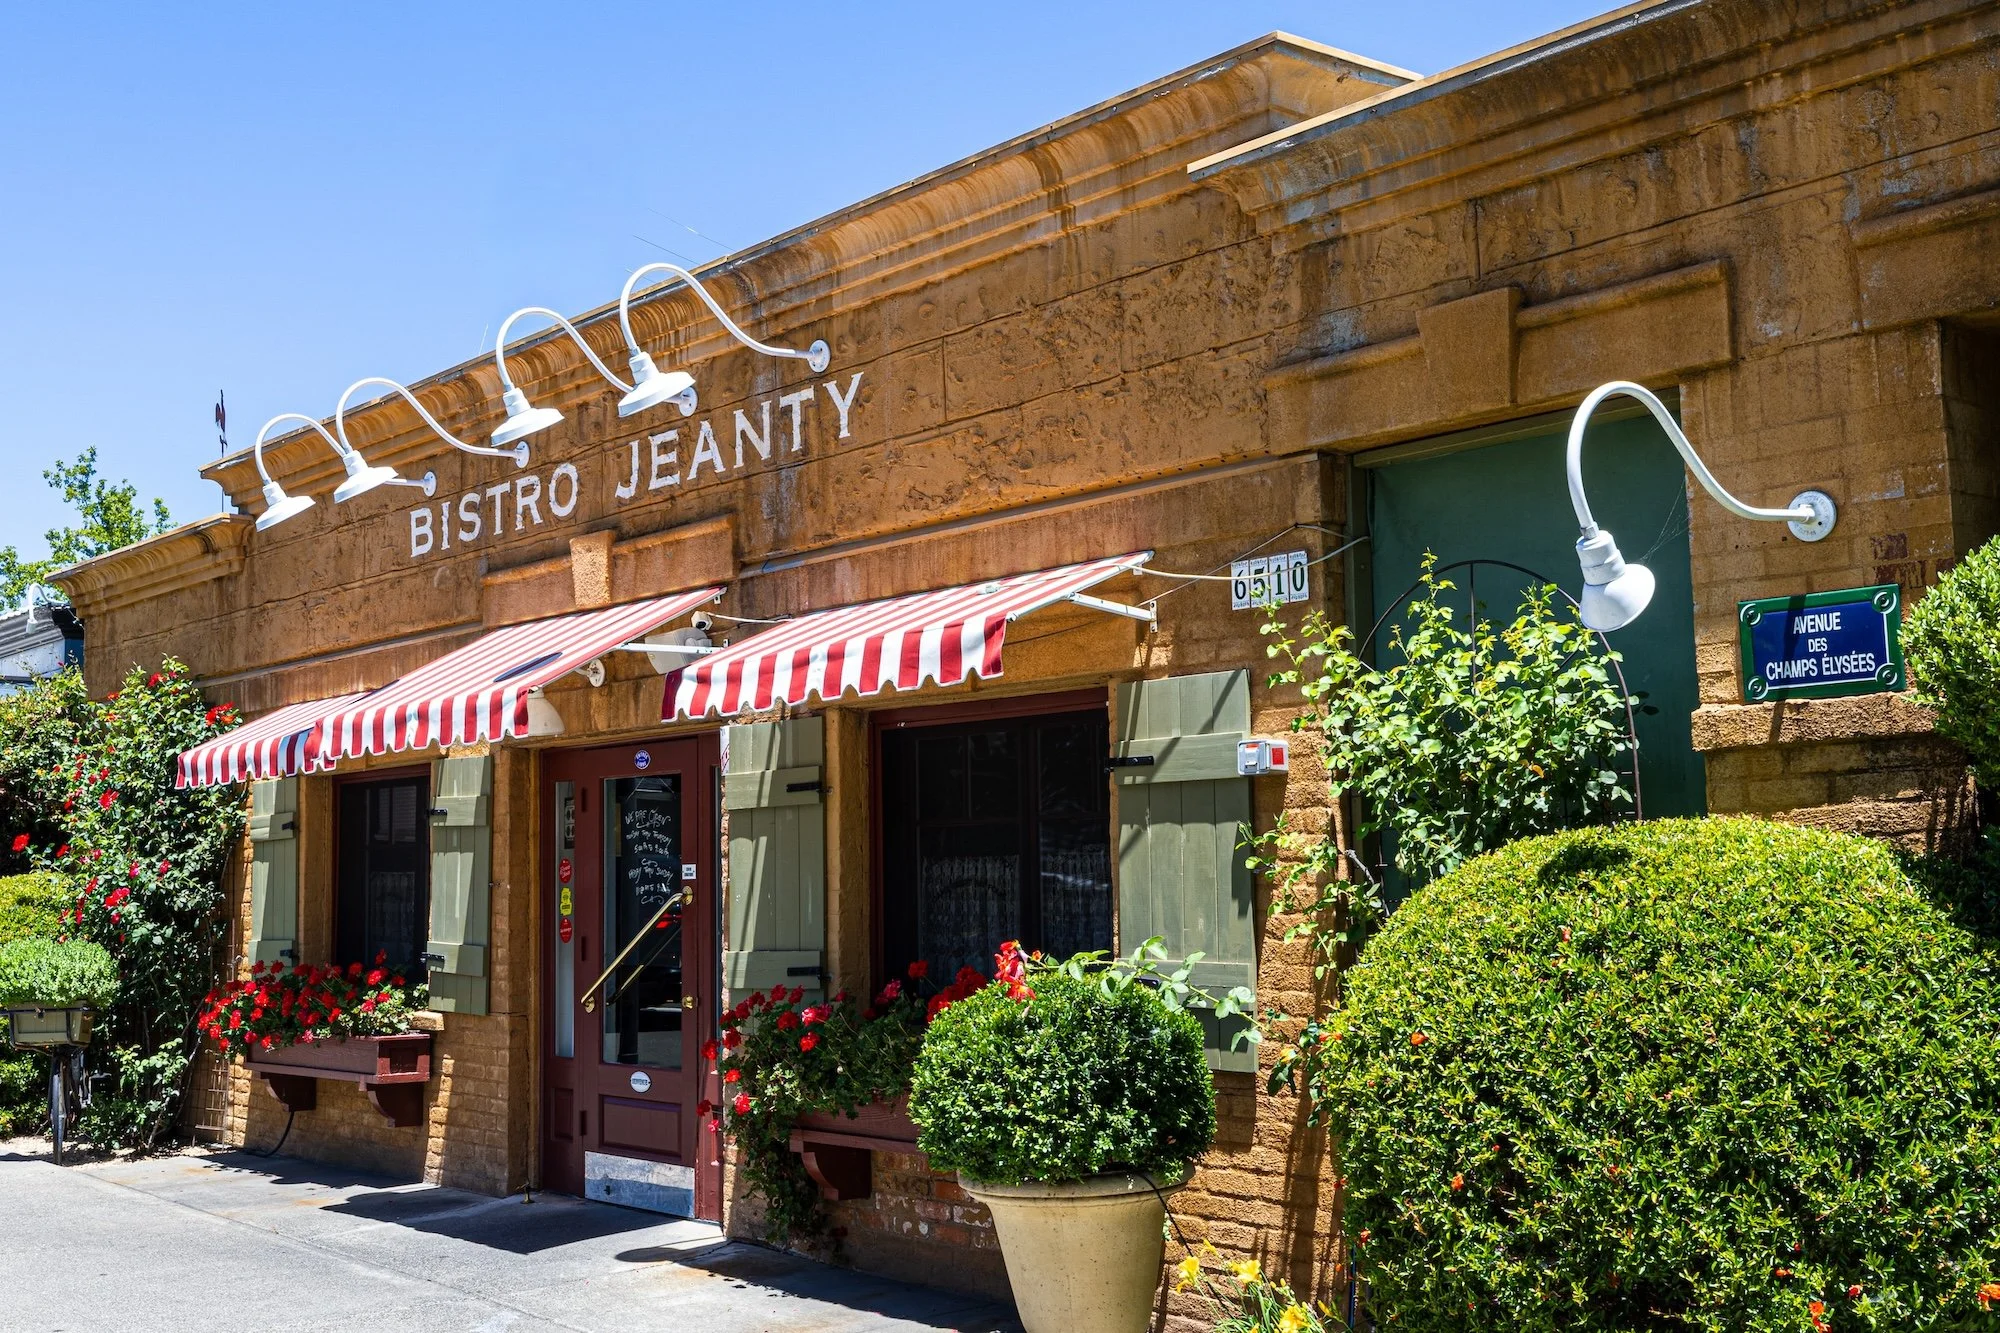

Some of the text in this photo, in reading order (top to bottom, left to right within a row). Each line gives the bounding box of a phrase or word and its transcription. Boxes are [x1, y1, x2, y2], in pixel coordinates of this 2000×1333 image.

[410, 371, 864, 559] BISTRO JEANTY
[1234, 561, 1305, 600] 6510
[1793, 611, 1842, 635] AVENUE
[1807, 637, 1828, 653] DES
[1766, 650, 1876, 681] CHAMPS ÉLYSÉES
[625, 810, 634, 825] WE
